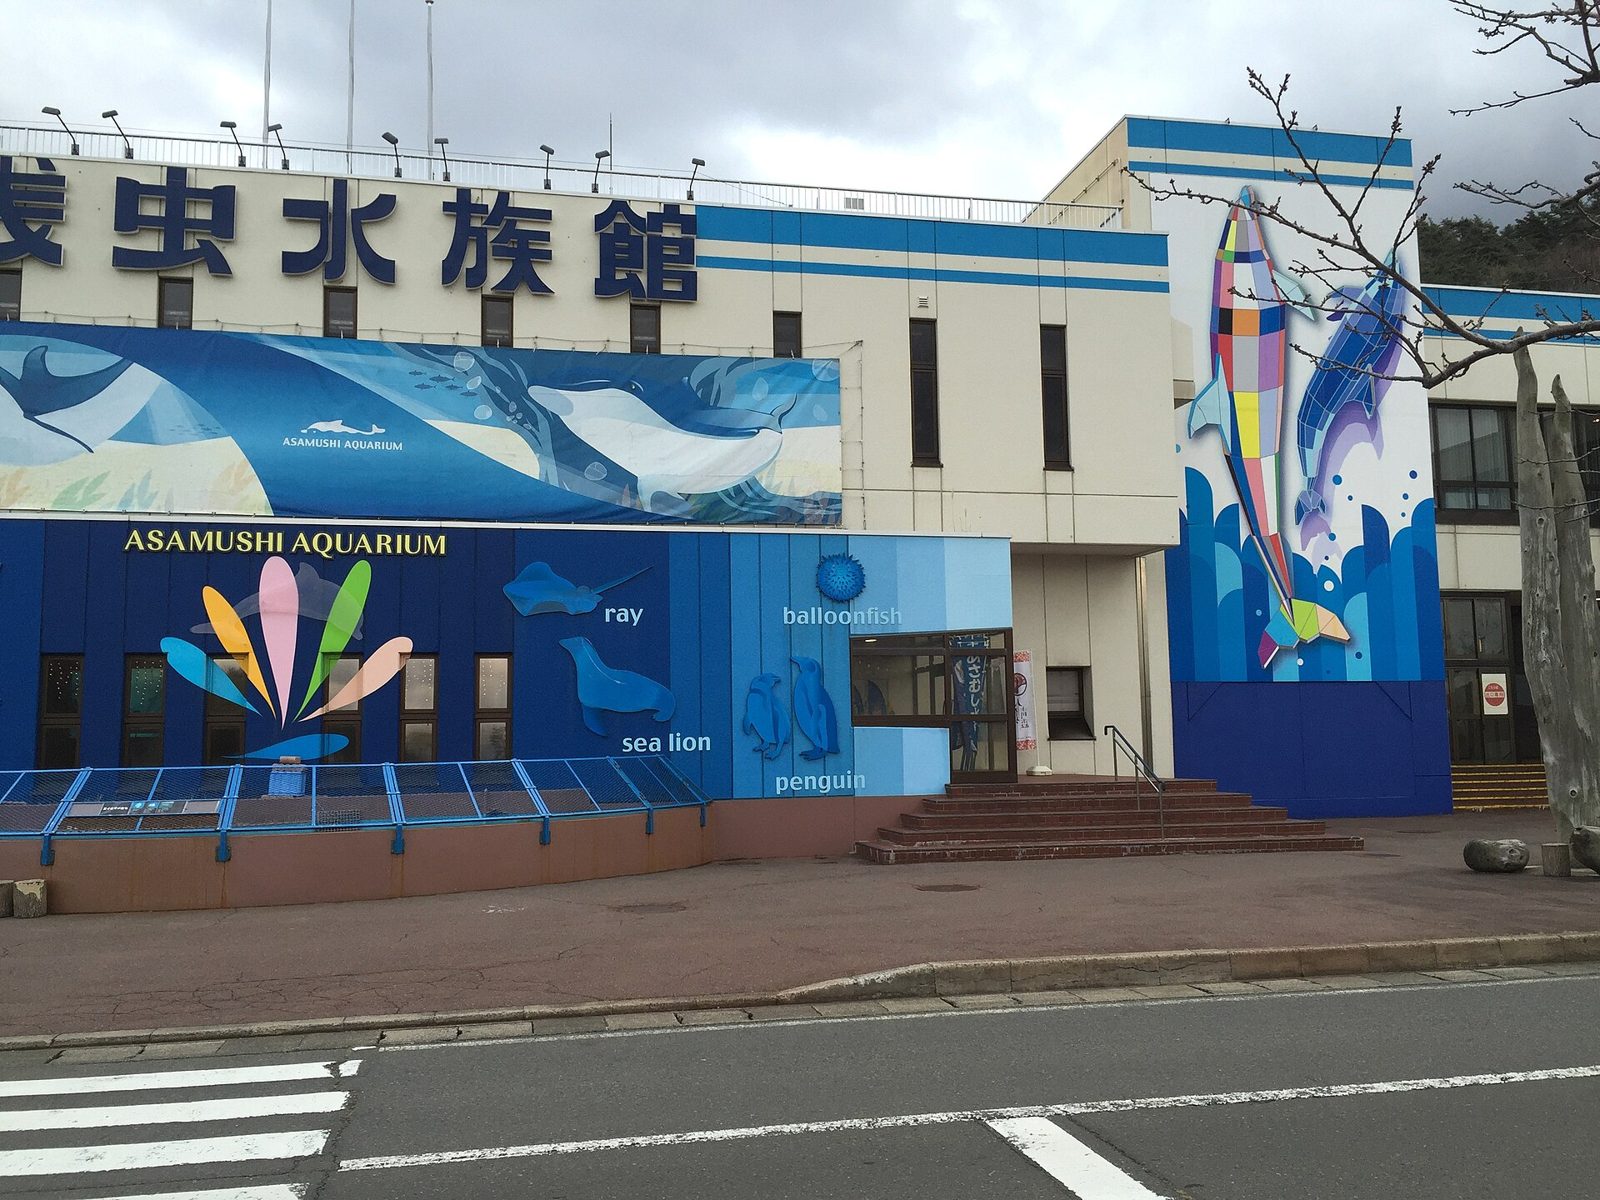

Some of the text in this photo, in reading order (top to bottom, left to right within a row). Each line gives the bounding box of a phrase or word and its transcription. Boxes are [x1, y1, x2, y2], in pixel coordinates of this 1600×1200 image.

[282, 437, 403, 451] ASAMUSHI AQUARIUM
[124, 529, 447, 559] ASAMUSHI AQUARIUM
[604, 607, 644, 627] ray
[783, 606, 903, 626] balloonfish
[622, 732, 711, 753] sea lion
[775, 770, 867, 795] penguin
